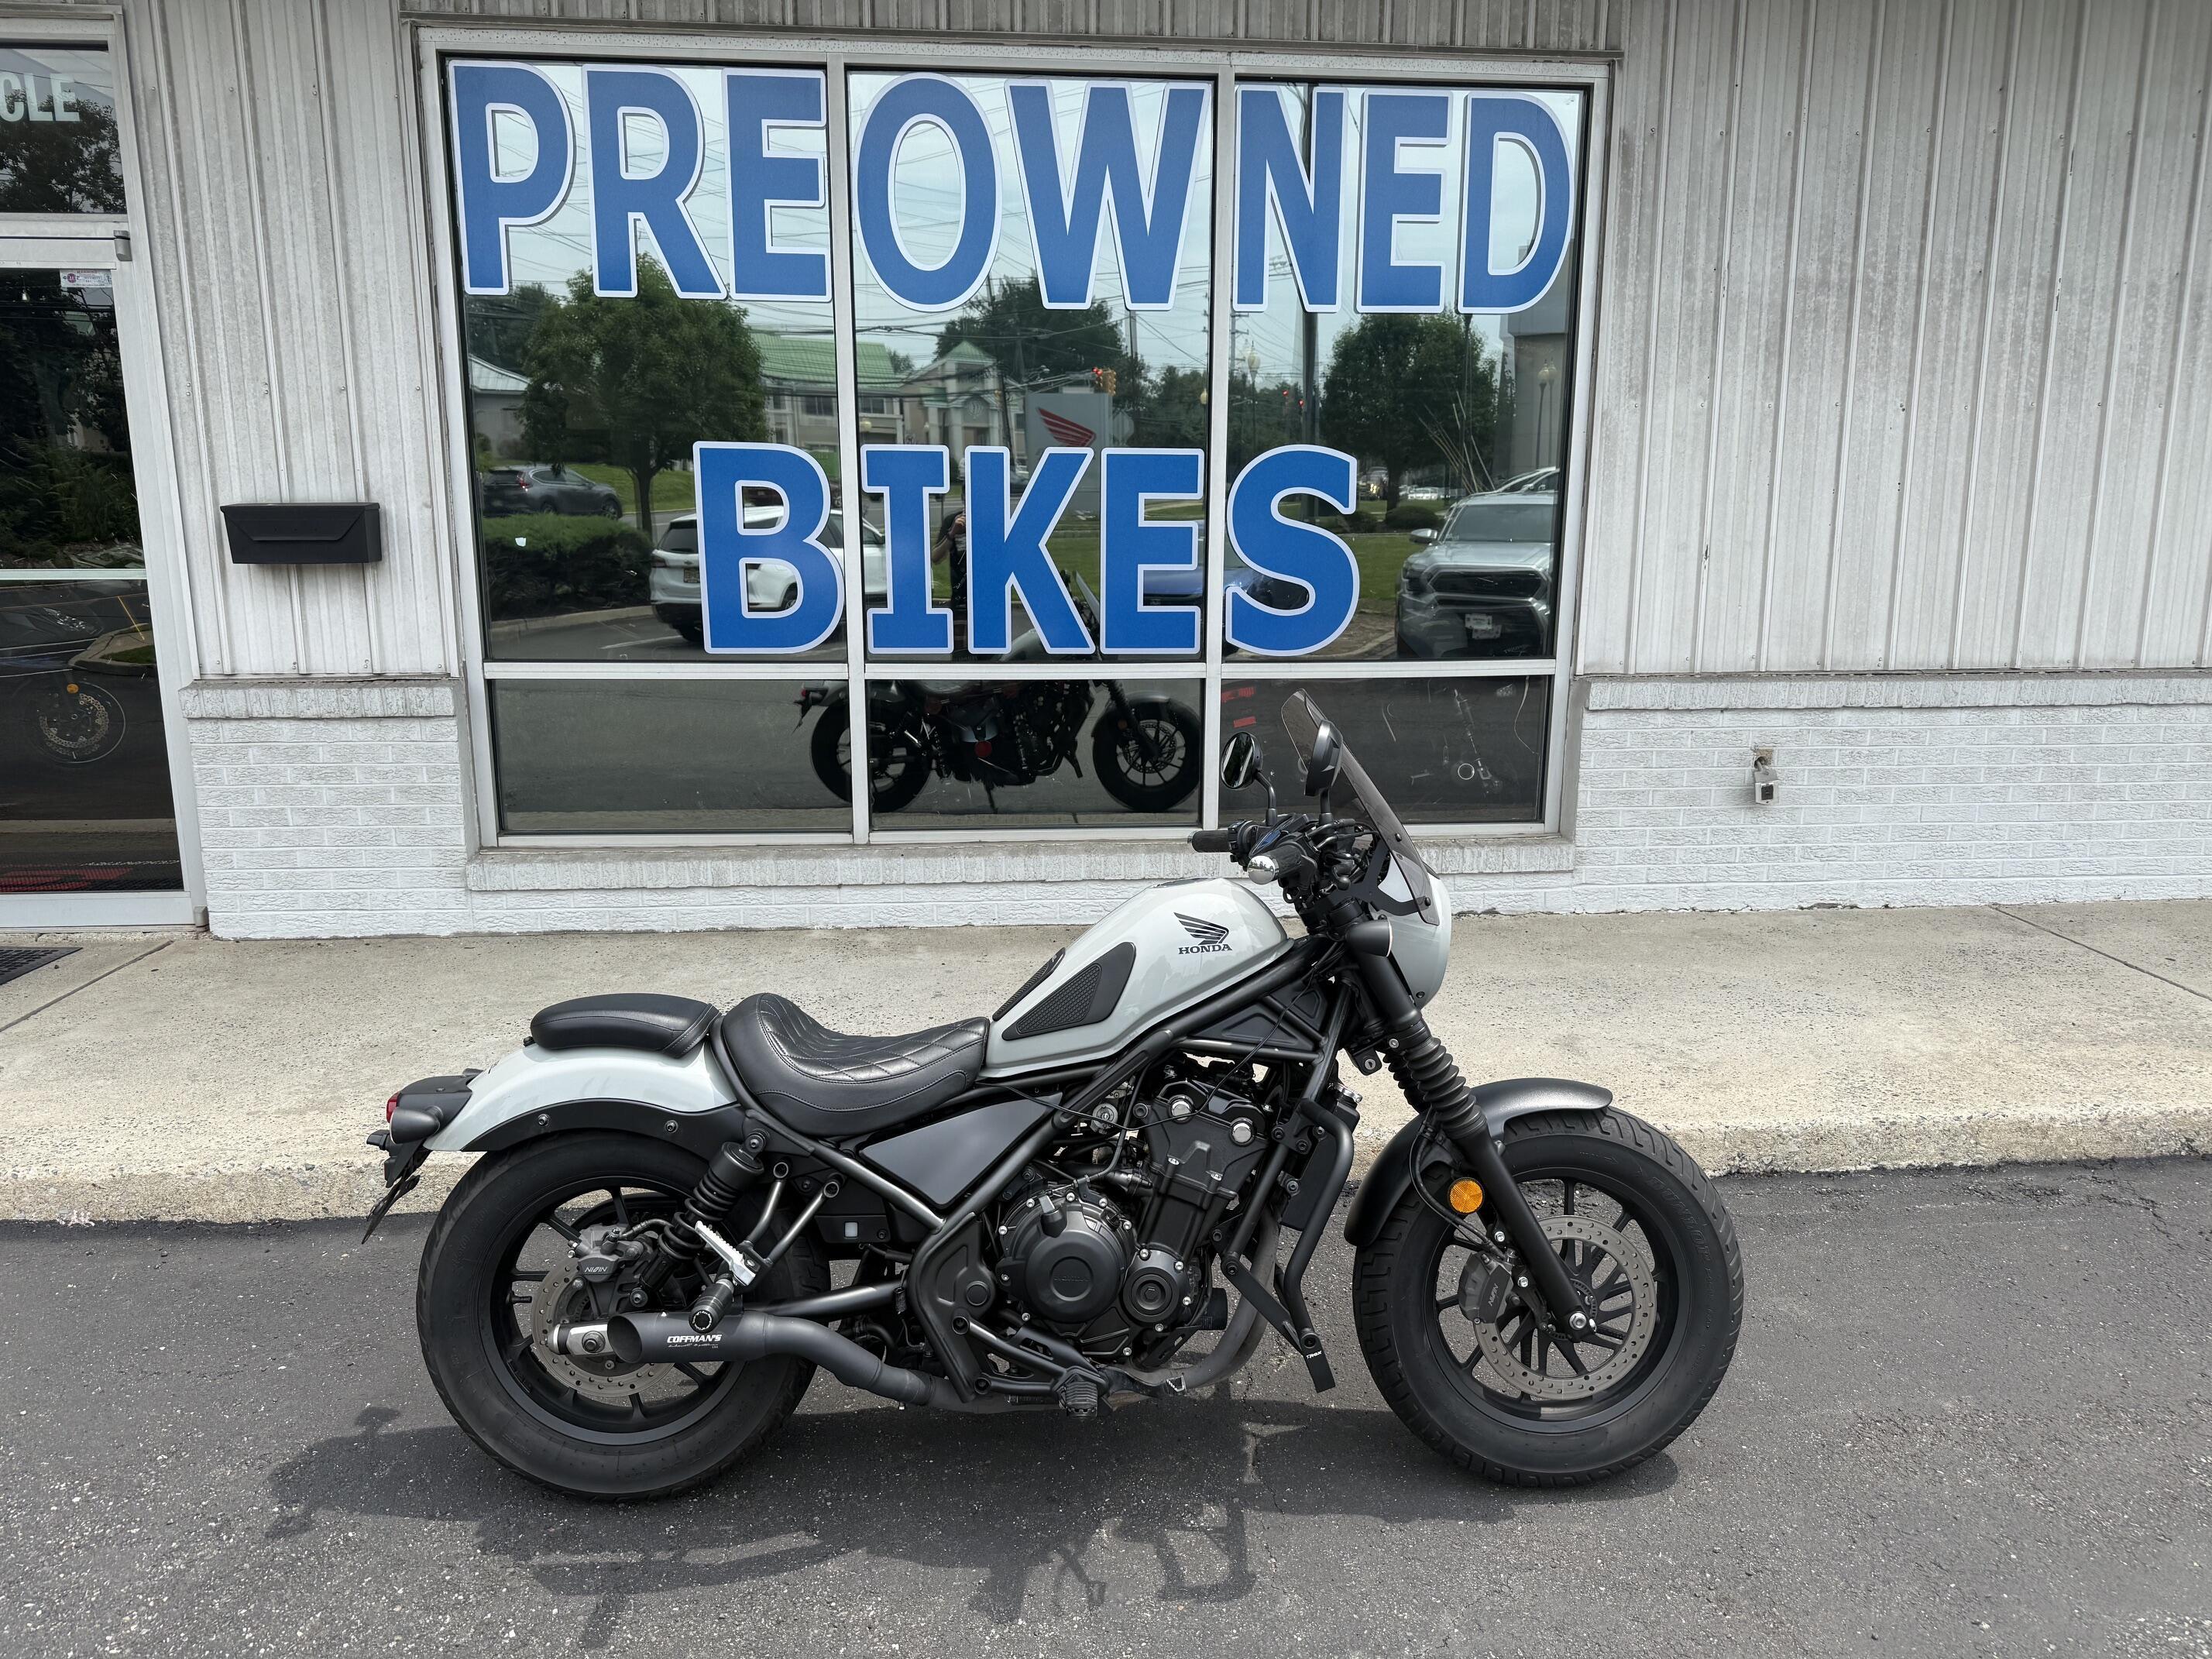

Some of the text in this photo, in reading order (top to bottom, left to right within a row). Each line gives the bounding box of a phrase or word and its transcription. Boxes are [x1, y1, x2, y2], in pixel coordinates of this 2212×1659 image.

[0, 72, 81, 122] CLE
[448, 60, 1575, 314] PREOWNED
[693, 444, 1360, 657] BIKES
[1178, 943, 1232, 954] HONDA
[667, 1334, 723, 1344] COFFMAN'S
